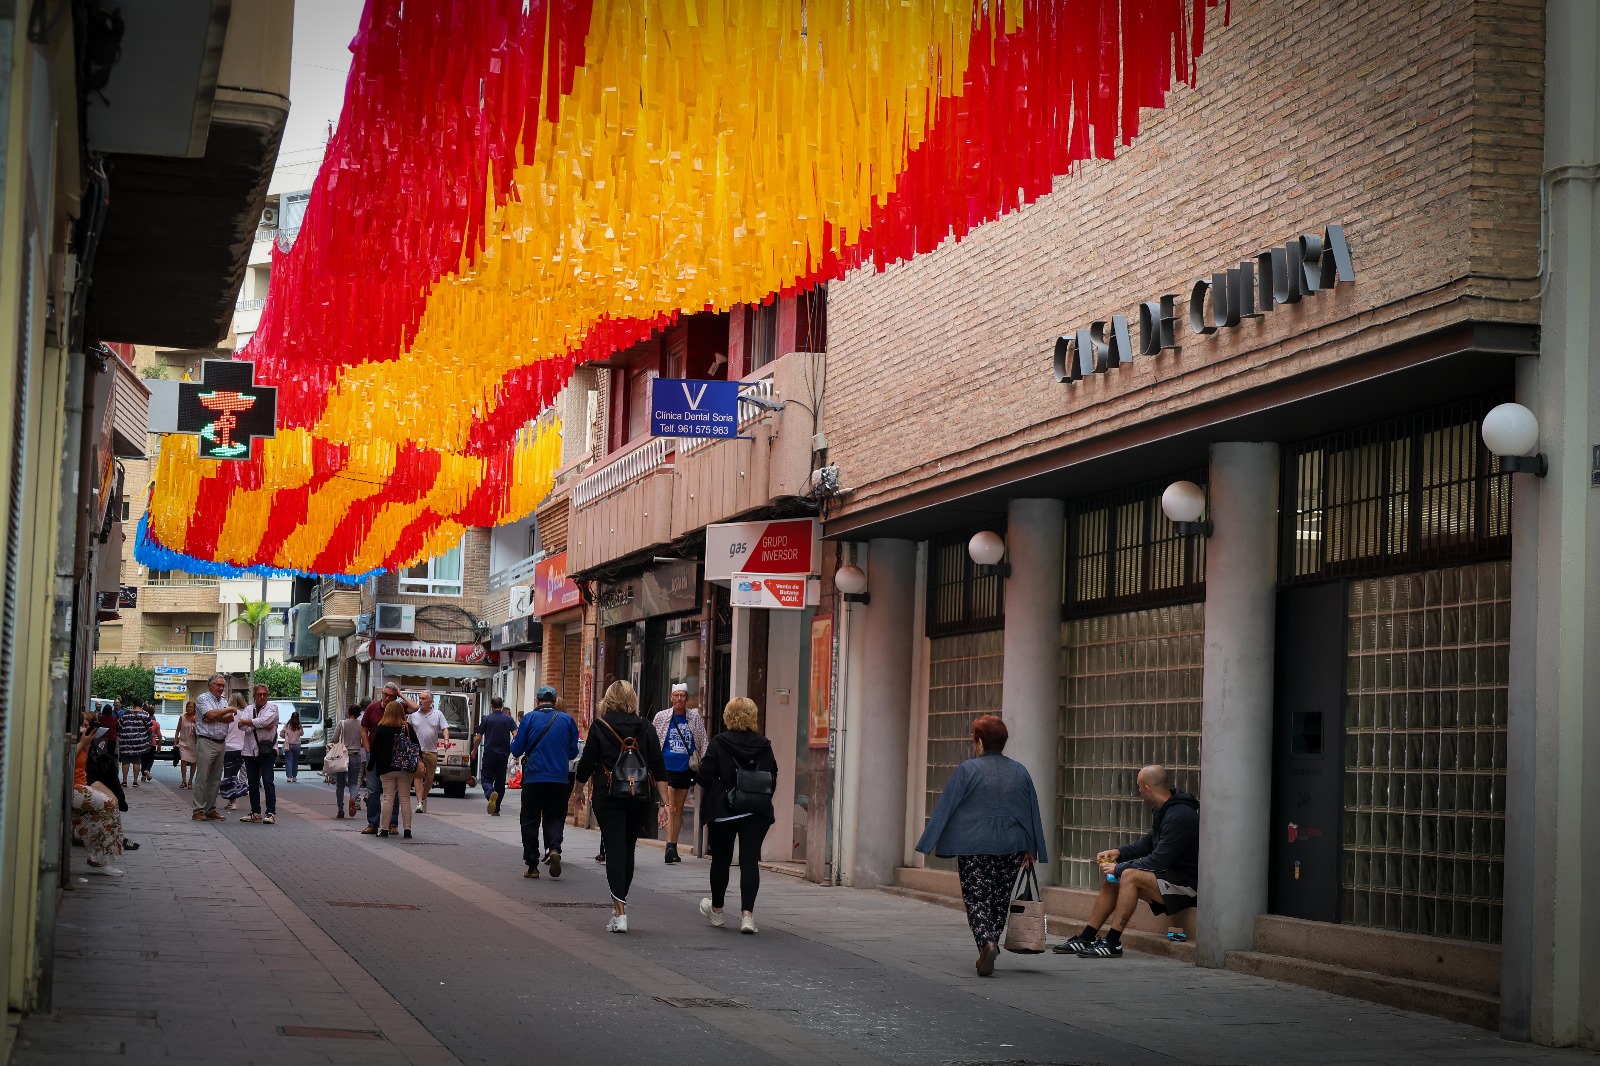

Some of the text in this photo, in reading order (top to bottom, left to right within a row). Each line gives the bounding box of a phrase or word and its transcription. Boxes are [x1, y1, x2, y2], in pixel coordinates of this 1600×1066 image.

[1053, 224, 1356, 384] CASA DE CULTURA
[655, 410, 733, 422] Clínica Dental Soria
[660, 423, 729, 435] Telf. 961 575 963
[762, 535, 788, 548] GRUPO
[729, 542, 748, 558] gas
[761, 548, 799, 561] INVERSOR
[429, 645, 452, 659] RAFI
